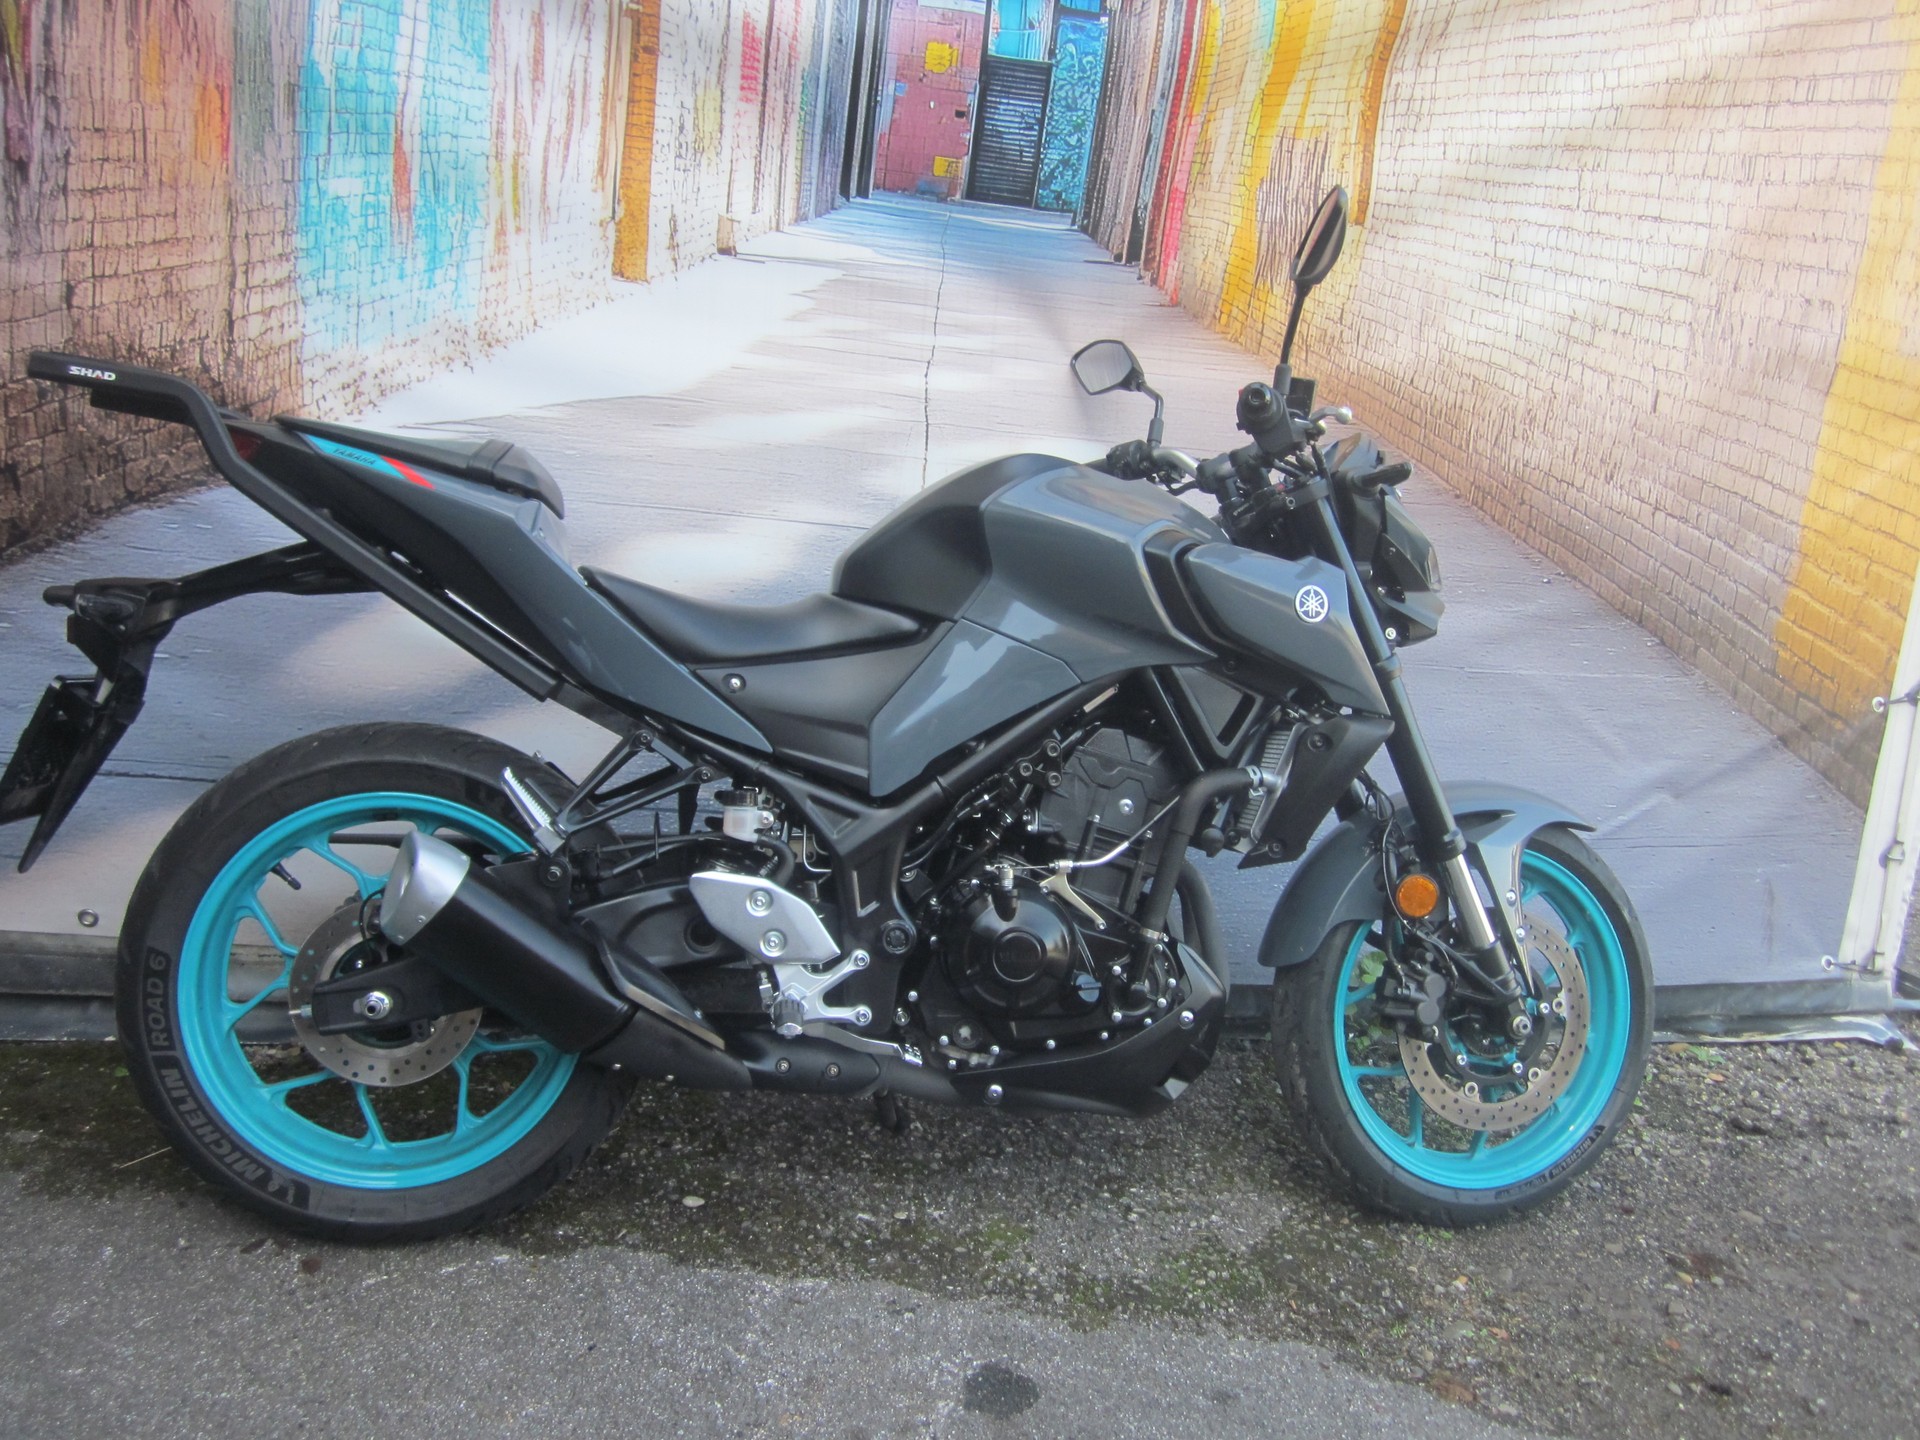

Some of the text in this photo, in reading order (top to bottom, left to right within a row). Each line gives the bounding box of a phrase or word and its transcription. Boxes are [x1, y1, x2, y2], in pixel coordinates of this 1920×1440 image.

[67, 365, 116, 381] SHAD
[333, 447, 376, 465] YAMAHA
[146, 953, 170, 1047] ROAD 6
[160, 1067, 266, 1181] MICHELIN
